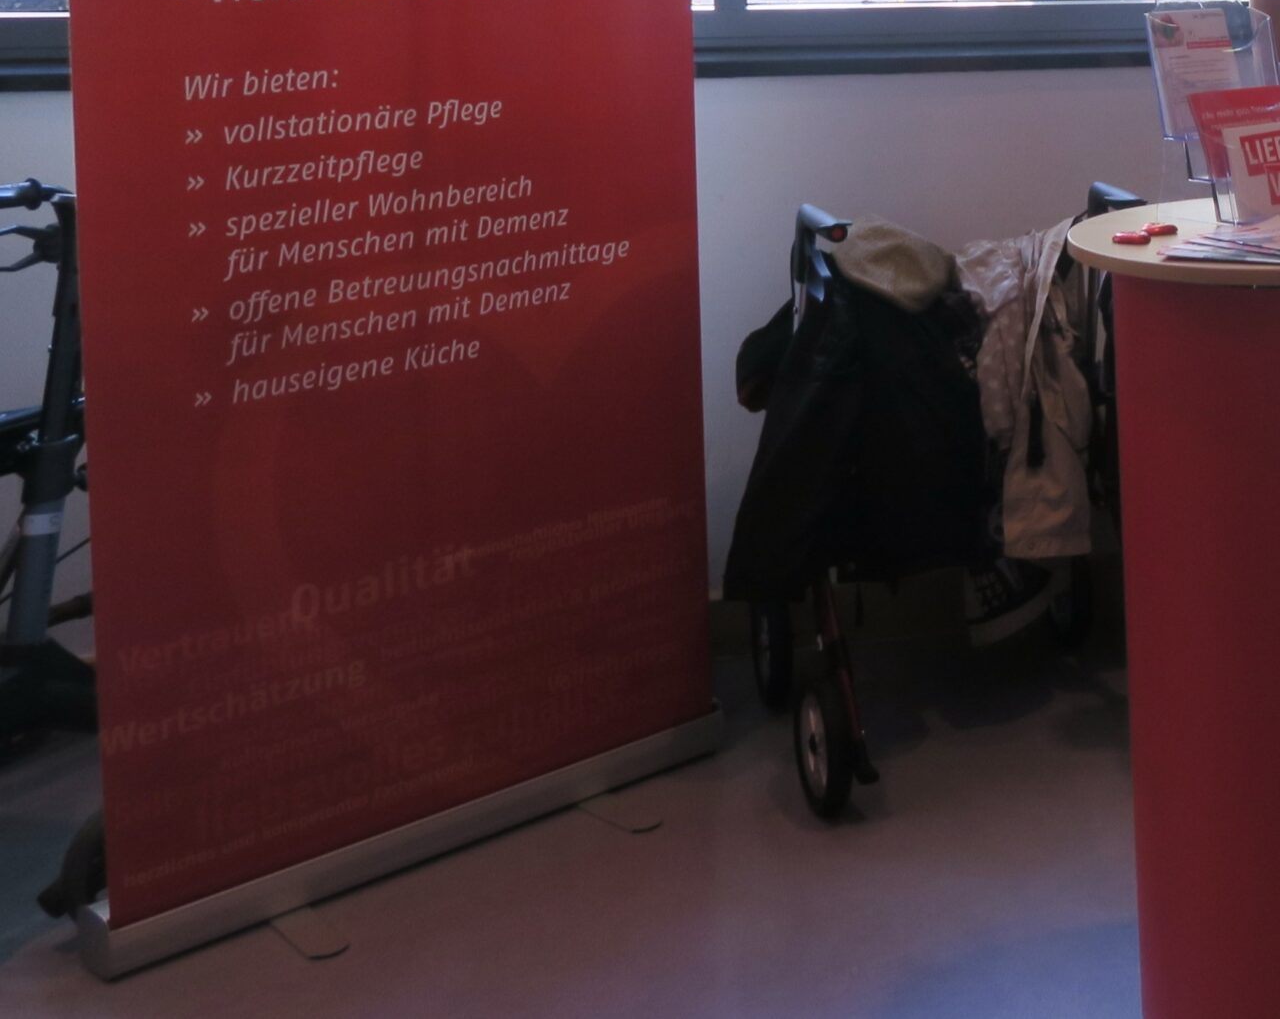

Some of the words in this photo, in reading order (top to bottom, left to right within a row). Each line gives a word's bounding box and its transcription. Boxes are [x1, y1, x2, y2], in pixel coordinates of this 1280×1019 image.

[184, 73, 232, 101] Wir
[243, 66, 340, 96] bieten:
[223, 104, 418, 145] vollstationäre
[427, 98, 503, 130] Pflege
[225, 148, 424, 192] Kurzzeitpflege
[225, 196, 358, 241] spezieller
[368, 175, 532, 219] Wohnbereich
[223, 247, 268, 282] für
[279, 229, 415, 268] Menschen
[425, 220, 469, 247] mit
[477, 206, 569, 239] Demenz
[229, 286, 318, 325] offene
[328, 238, 631, 304] Betreuungsnachmittage
[227, 331, 272, 366] für
[281, 308, 417, 349] Menschen
[428, 297, 471, 326] mit
[479, 281, 571, 316] Demenz
[231, 355, 395, 405] hauseigene
[404, 337, 481, 372] Küche
